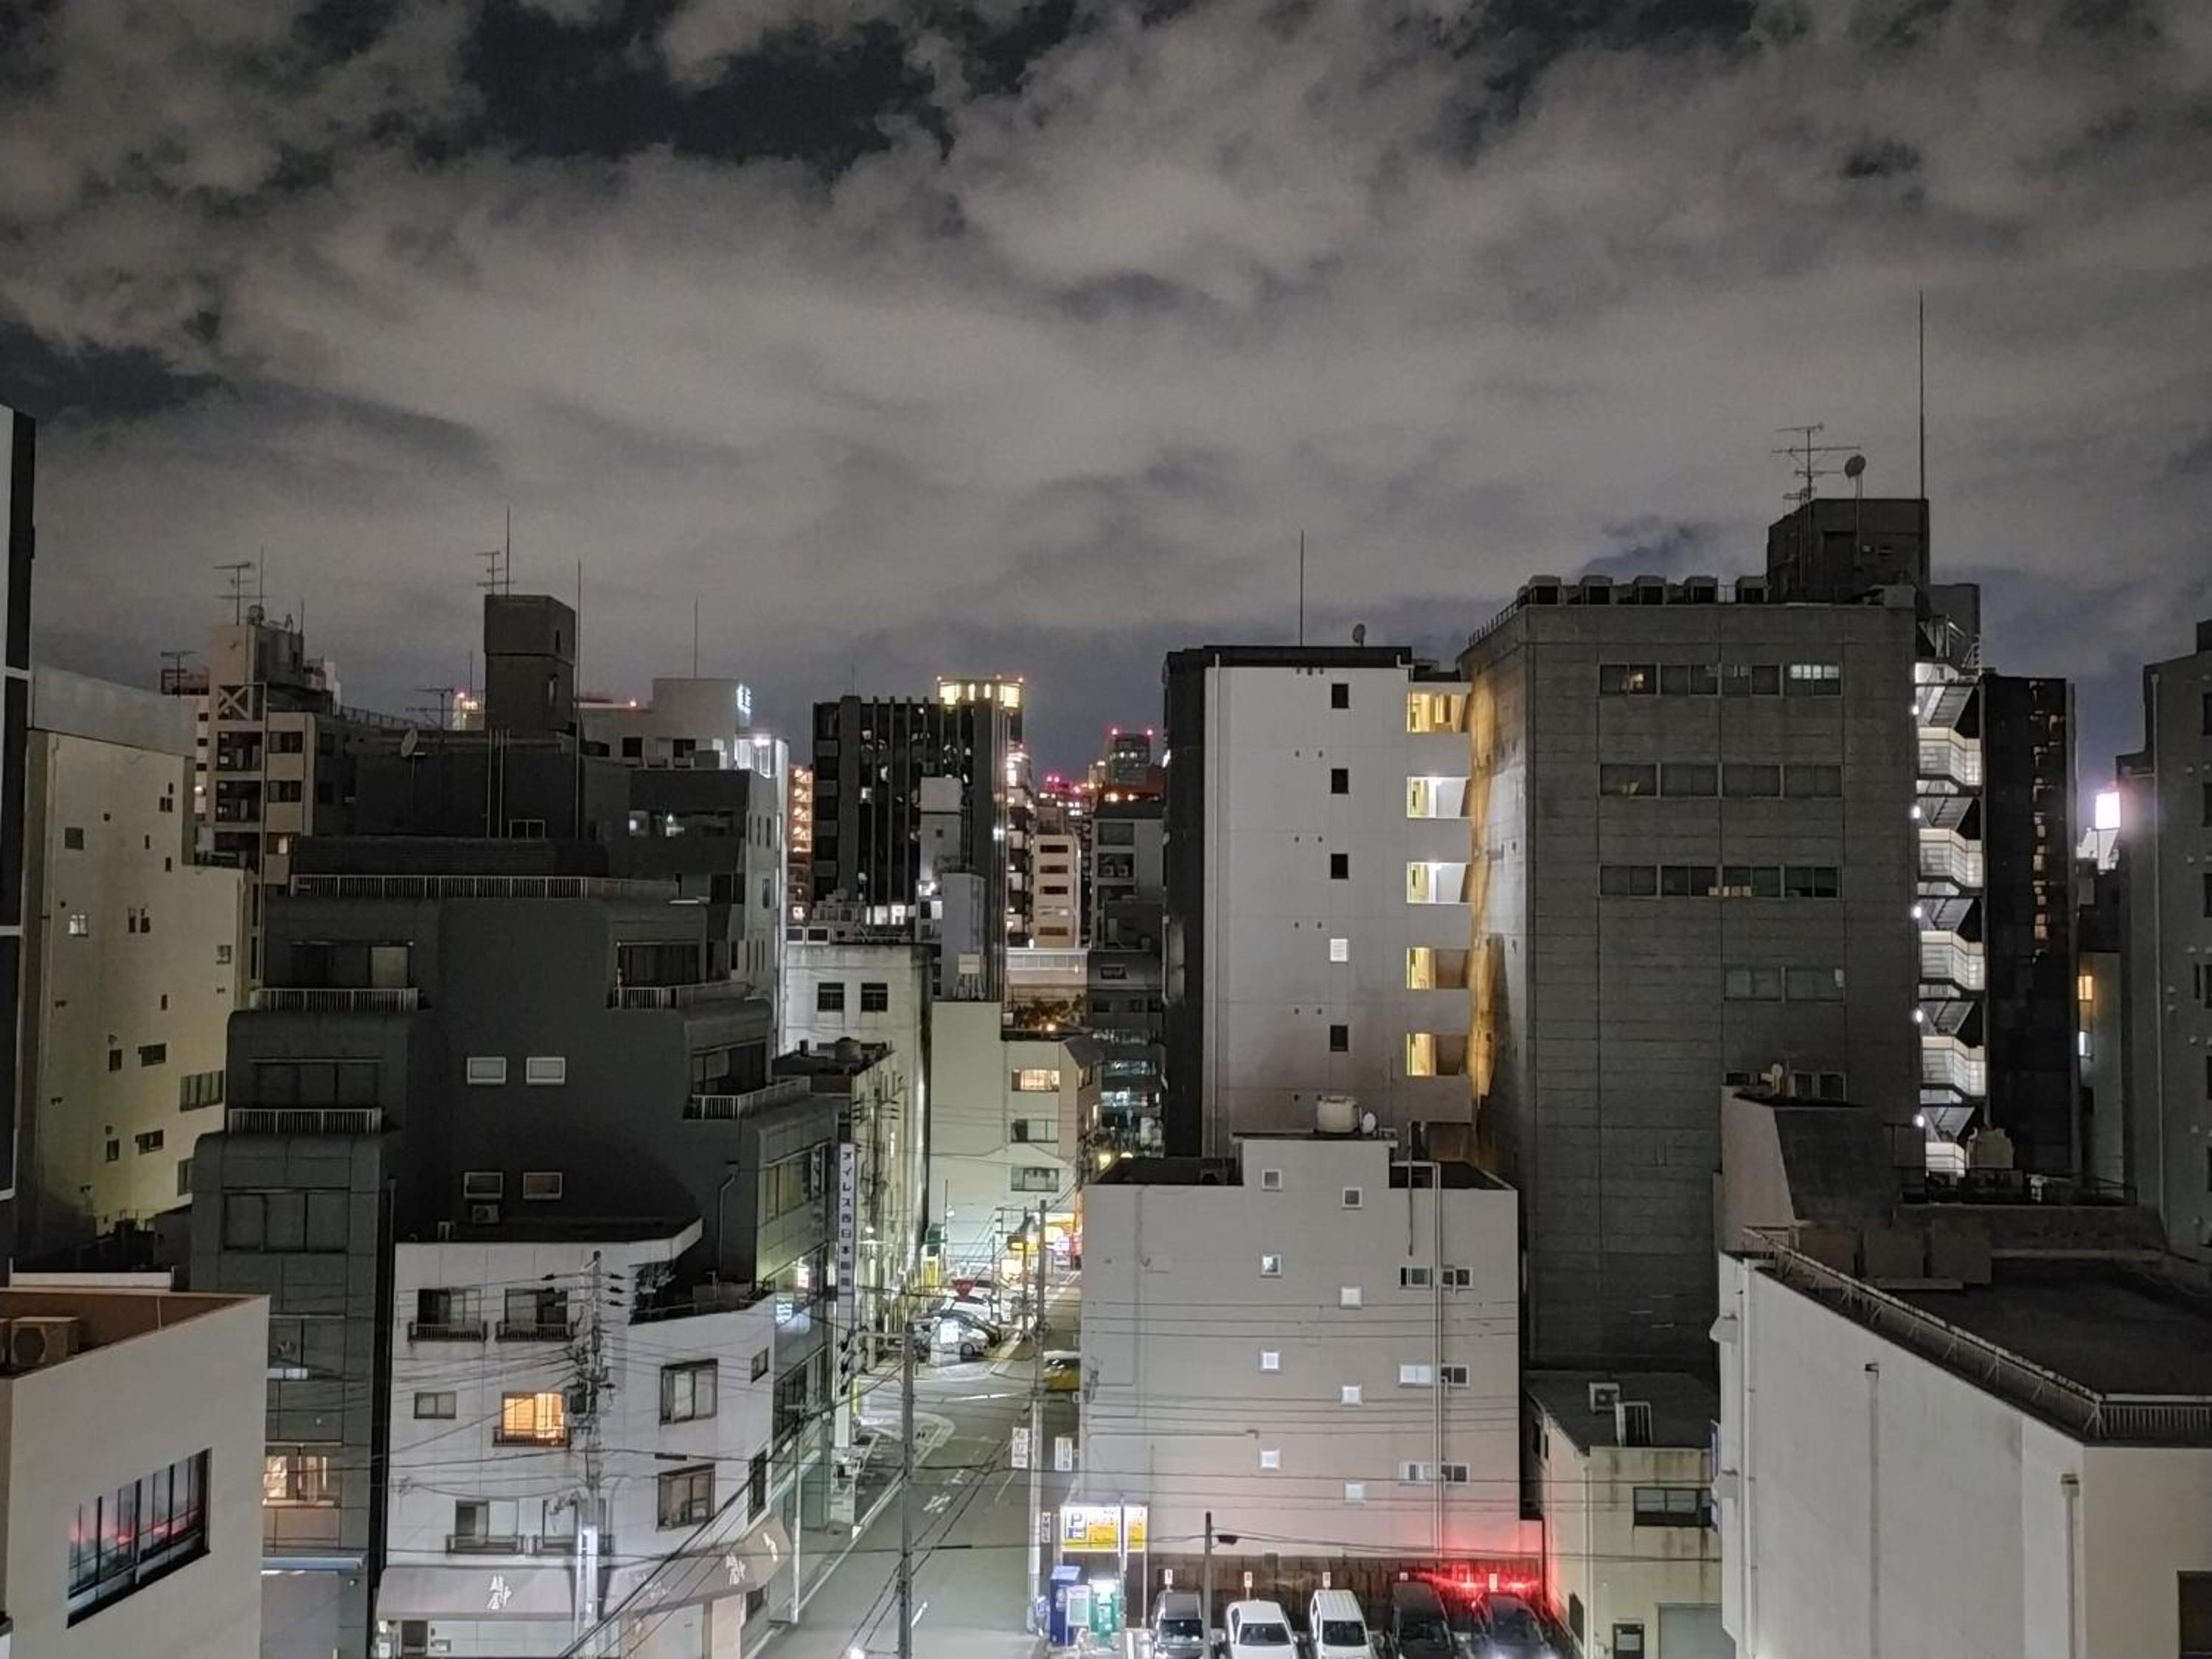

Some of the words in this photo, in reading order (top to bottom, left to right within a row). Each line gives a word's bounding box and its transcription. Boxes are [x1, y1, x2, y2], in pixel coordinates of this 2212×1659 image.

[841, 1152, 852, 1287] オイレス西日本
[1071, 1512, 1083, 1528] P
